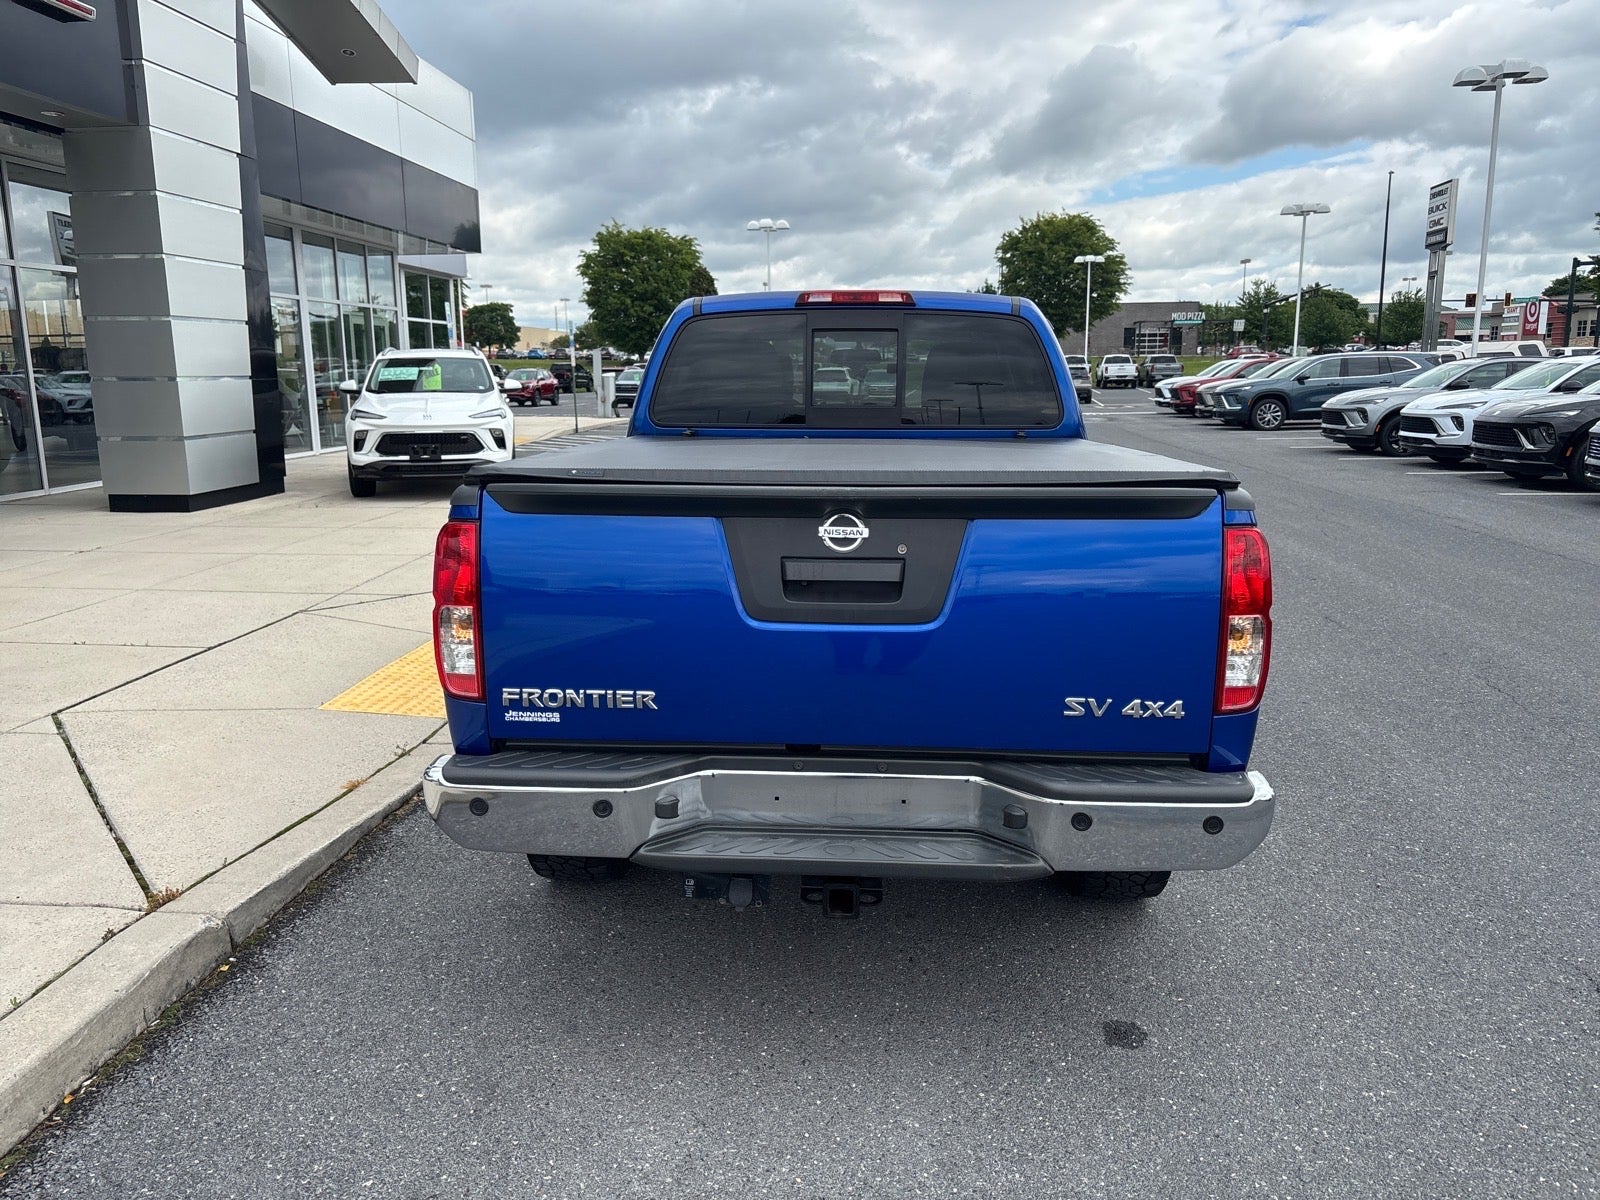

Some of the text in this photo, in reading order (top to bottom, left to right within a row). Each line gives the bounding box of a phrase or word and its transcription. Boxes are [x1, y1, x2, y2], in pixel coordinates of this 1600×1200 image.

[1428, 201, 1448, 215] BUICK
[1429, 217, 1444, 229] GMC
[1171, 312, 1206, 321] MOD PIZZA
[502, 687, 658, 710] FRONTIER
[1063, 697, 1113, 718] SV
